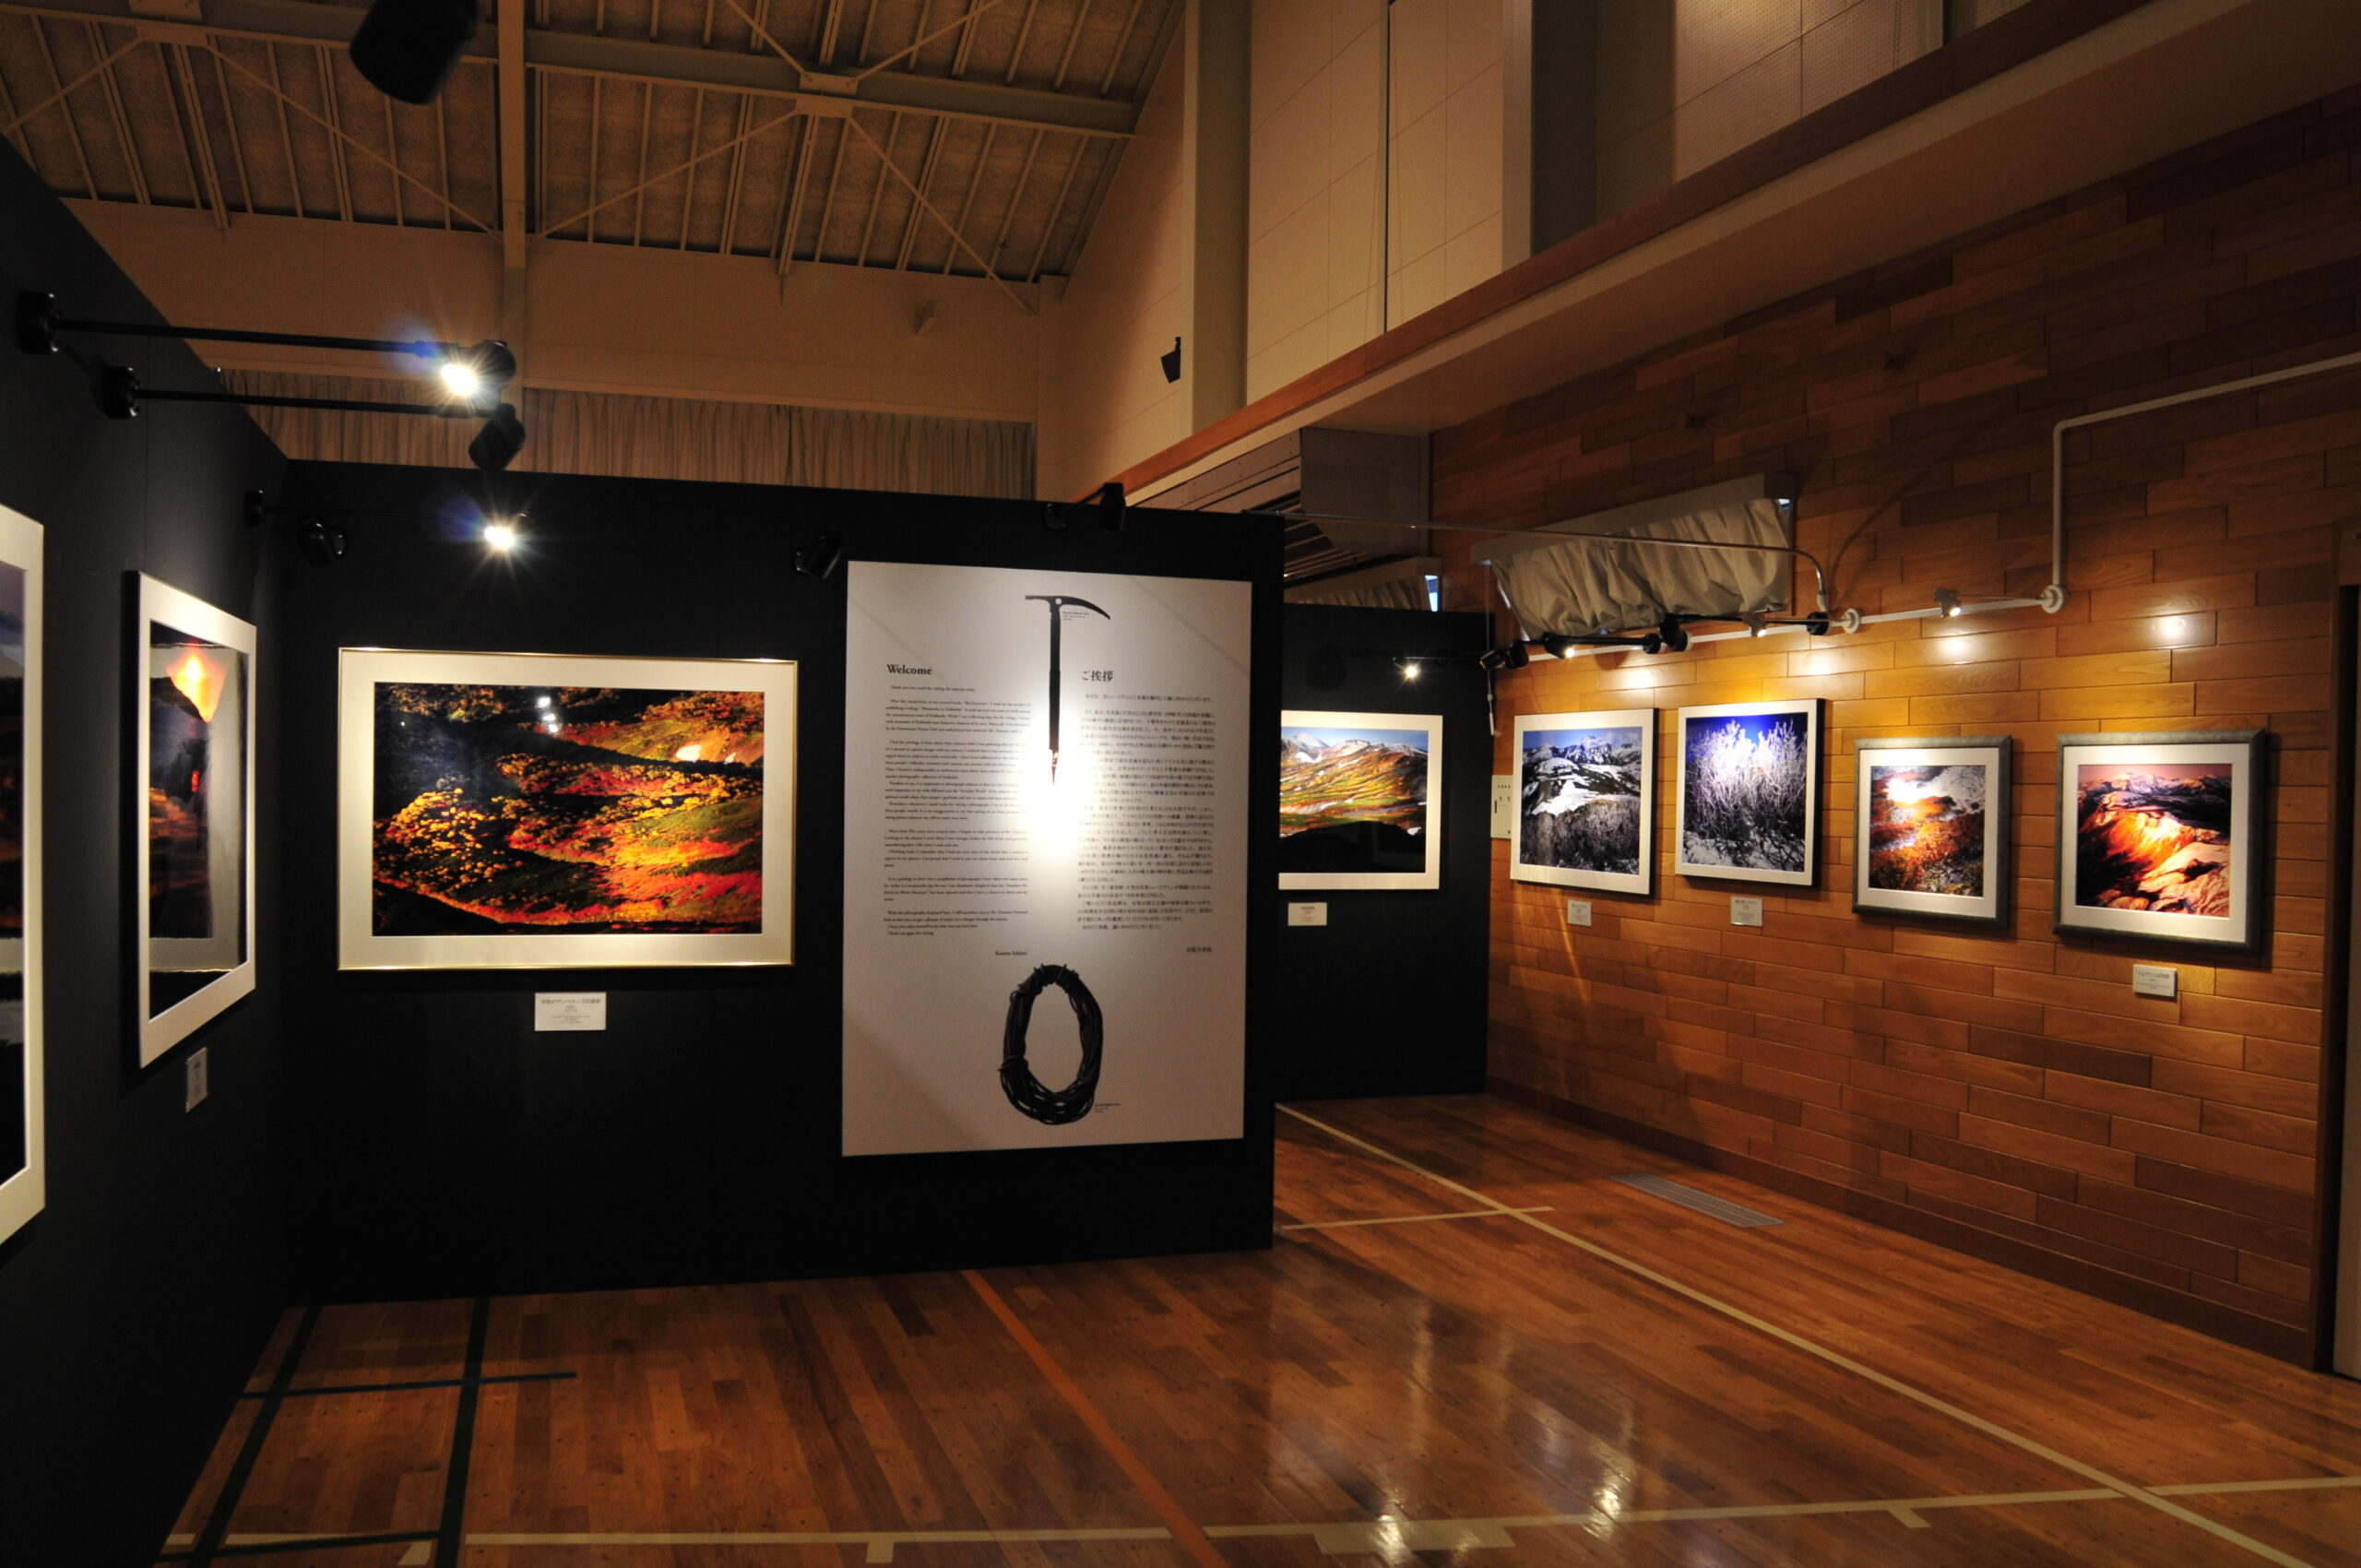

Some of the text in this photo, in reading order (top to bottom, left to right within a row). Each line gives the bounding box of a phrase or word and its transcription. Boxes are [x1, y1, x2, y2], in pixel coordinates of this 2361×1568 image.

[886, 663, 932, 675] Welcome
[1082, 670, 1113, 682] ご挨拶
